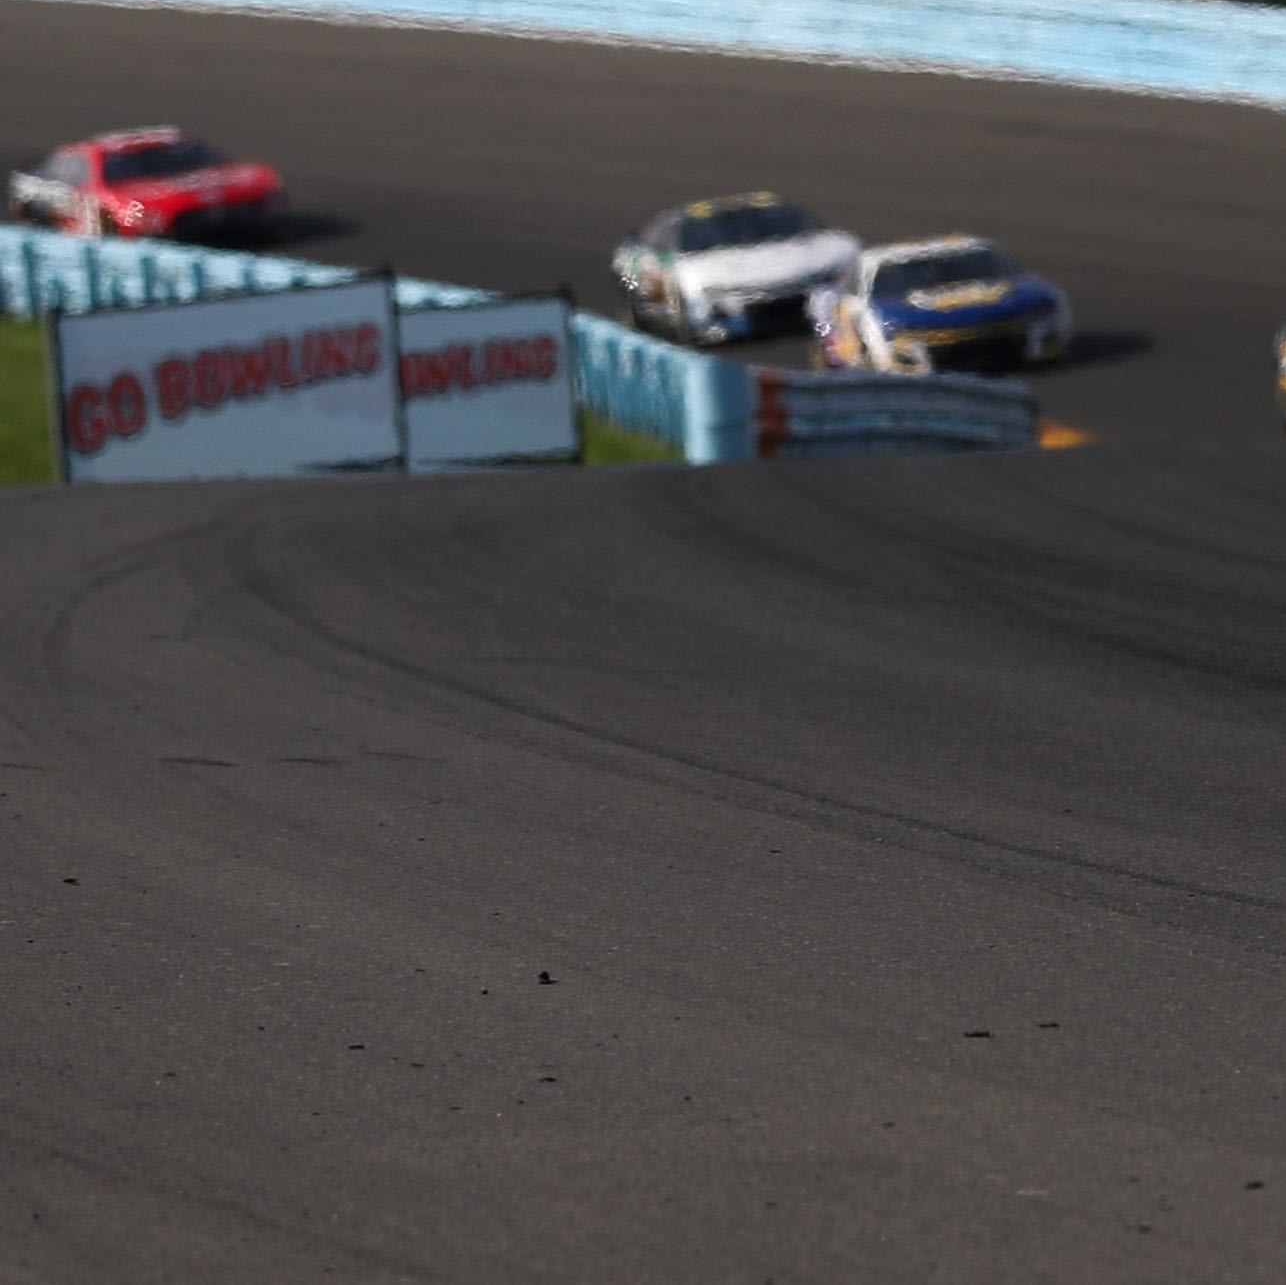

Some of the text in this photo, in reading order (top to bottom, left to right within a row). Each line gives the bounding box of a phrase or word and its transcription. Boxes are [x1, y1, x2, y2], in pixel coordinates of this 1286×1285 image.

[66, 323, 382, 456] GO BOWLING
[401, 334, 558, 400] OWLING
